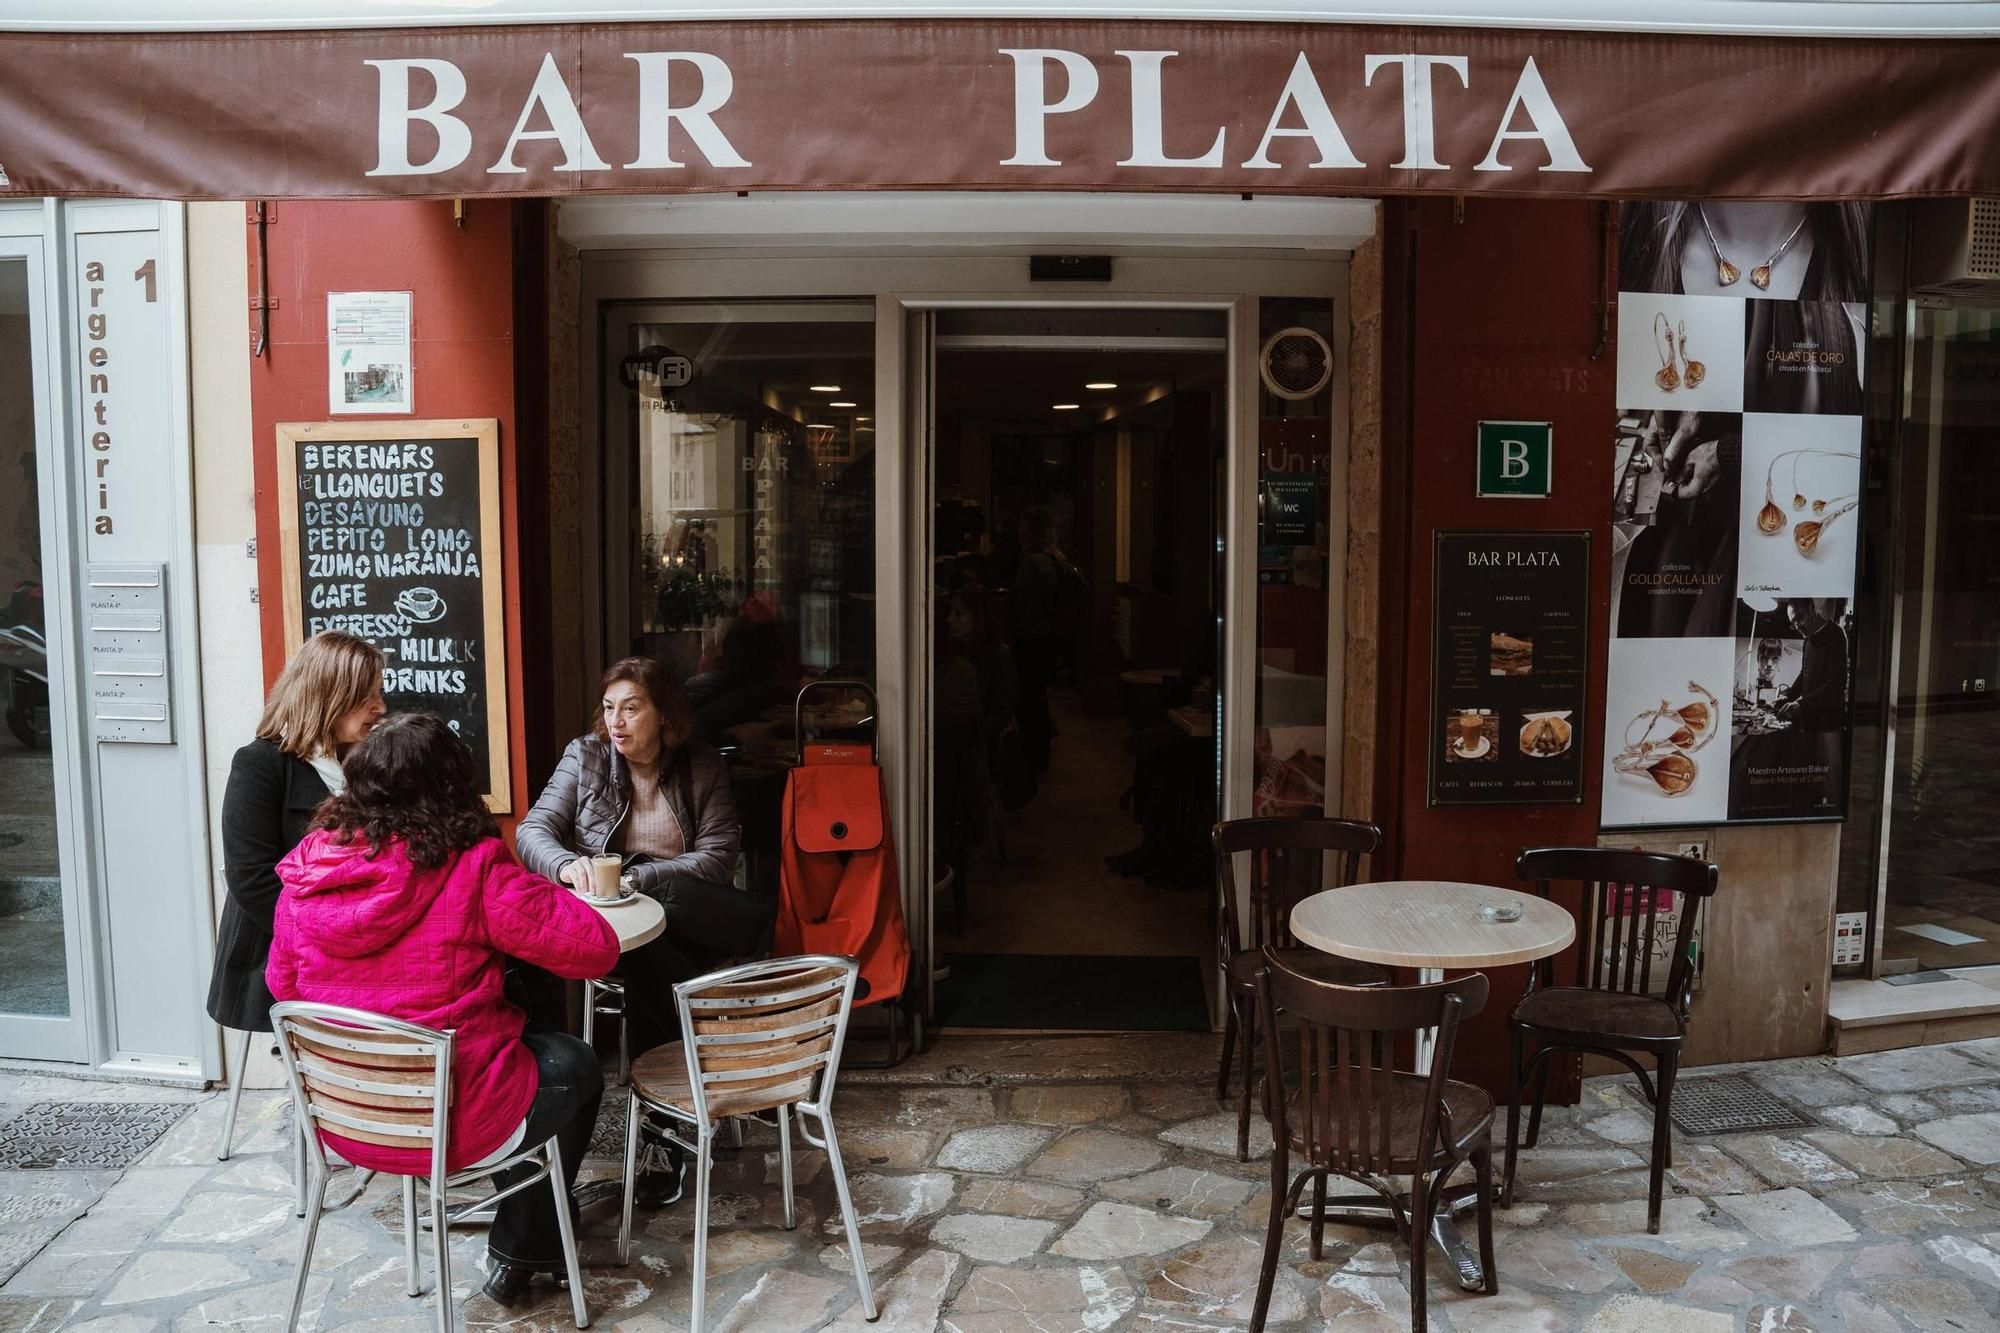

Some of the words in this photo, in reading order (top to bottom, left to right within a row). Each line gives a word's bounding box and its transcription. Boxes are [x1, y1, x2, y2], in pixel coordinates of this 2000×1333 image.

[363, 52, 752, 176] BAR
[999, 48, 1593, 173] PLATA
[134, 260, 158, 303] 1
[1766, 350, 1801, 362] CALAS
[1803, 351, 1817, 362] DE
[1820, 352, 1845, 364] ORO
[86, 260, 114, 536] argenteria
[304, 443, 434, 470] BERENARS
[741, 456, 790, 472] BAR
[1500, 439, 1531, 479] B
[314, 471, 444, 500] LLONGUETS
[304, 500, 425, 527] DESAYUNO
[1283, 503, 1300, 513] WC
[752, 479, 774, 569] PLATA
[307, 527, 386, 552] PEPITO
[408, 528, 472, 552] LOMO
[308, 552, 371, 578] ZUMO
[375, 551, 480, 578] NARANJA
[1468, 551, 1501, 566] BAR
[1506, 551, 1561, 566] PLATA
[1629, 573, 1661, 585] GOLD
[310, 583, 367, 609] CAFE
[382, 667, 467, 693] DRINKS
[1747, 767, 1777, 775] Maestro
[1777, 766, 1808, 774] Artesano
[1808, 764, 1830, 773] Balear
